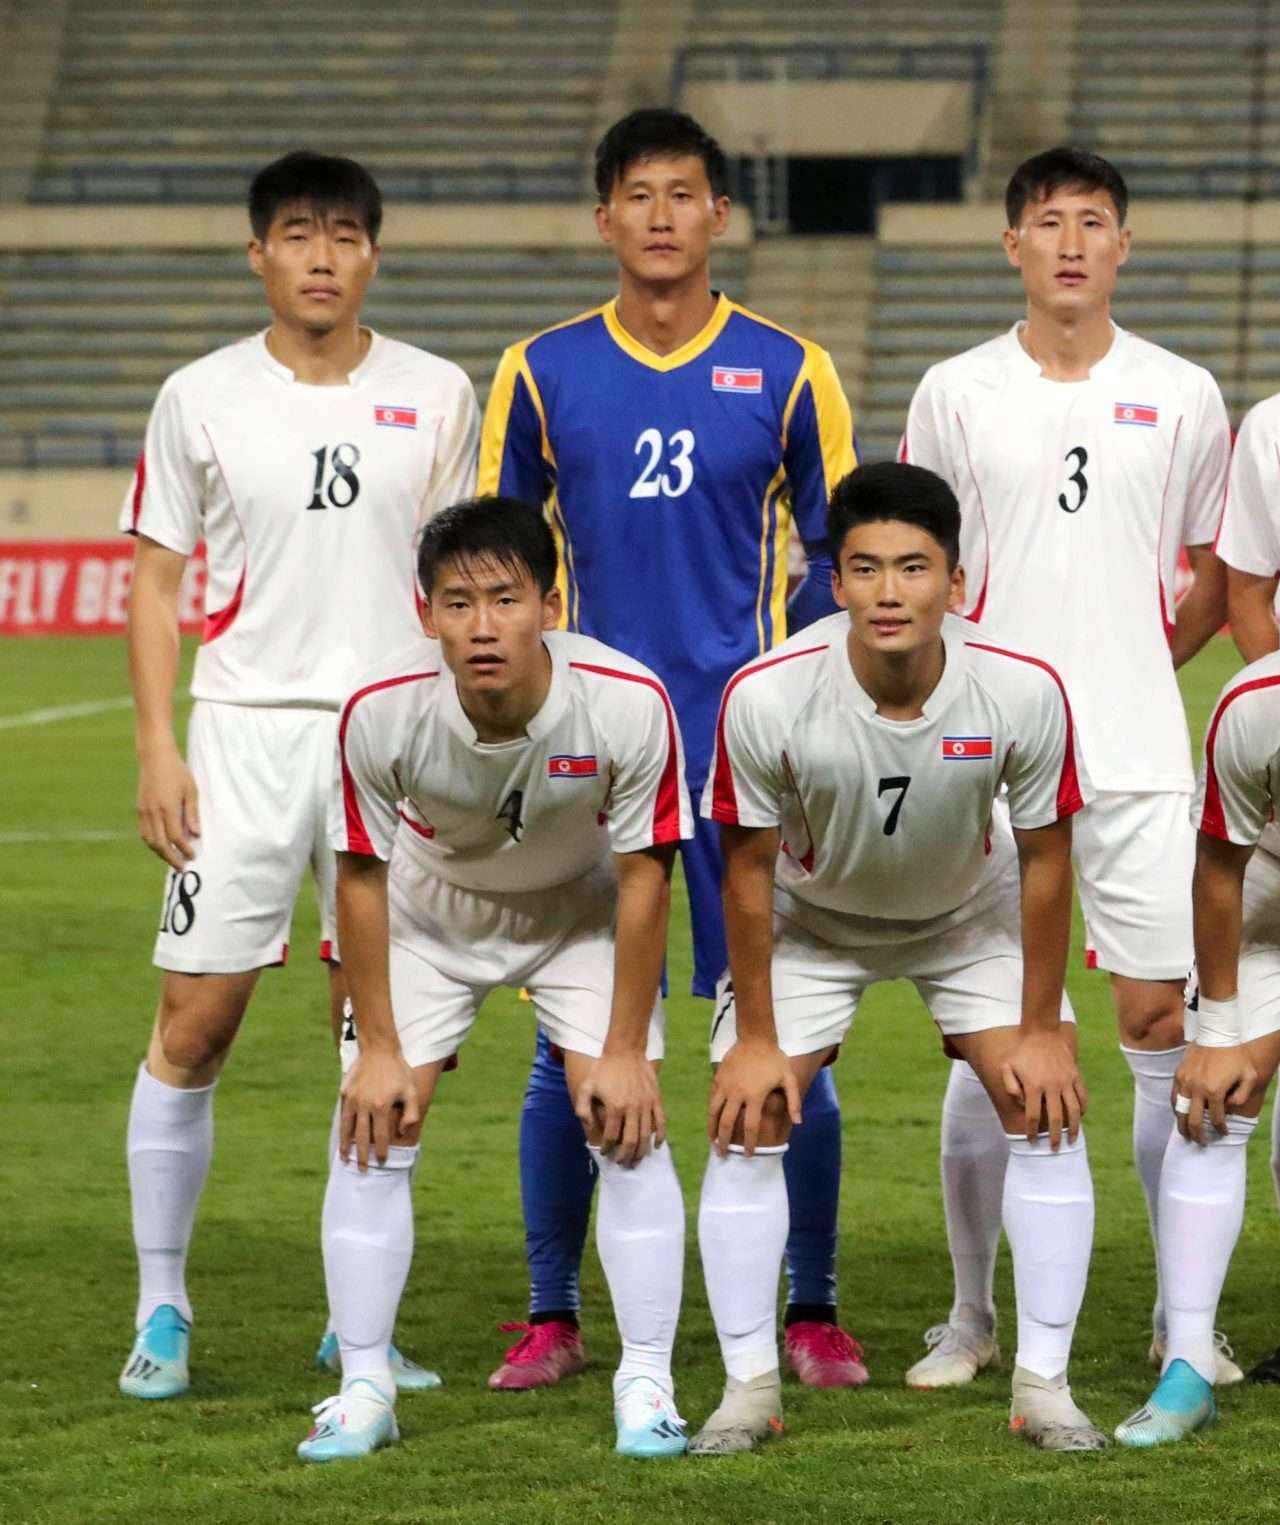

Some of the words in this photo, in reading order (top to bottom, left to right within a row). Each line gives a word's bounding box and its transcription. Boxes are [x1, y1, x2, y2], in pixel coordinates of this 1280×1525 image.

[306, 443, 361, 511] 18
[628, 427, 696, 499] 23
[1057, 445, 1089, 514] 3
[0, 558, 69, 624] FLY
[495, 789, 524, 844] 4
[877, 775, 912, 837] 7
[160, 870, 202, 936] 18
